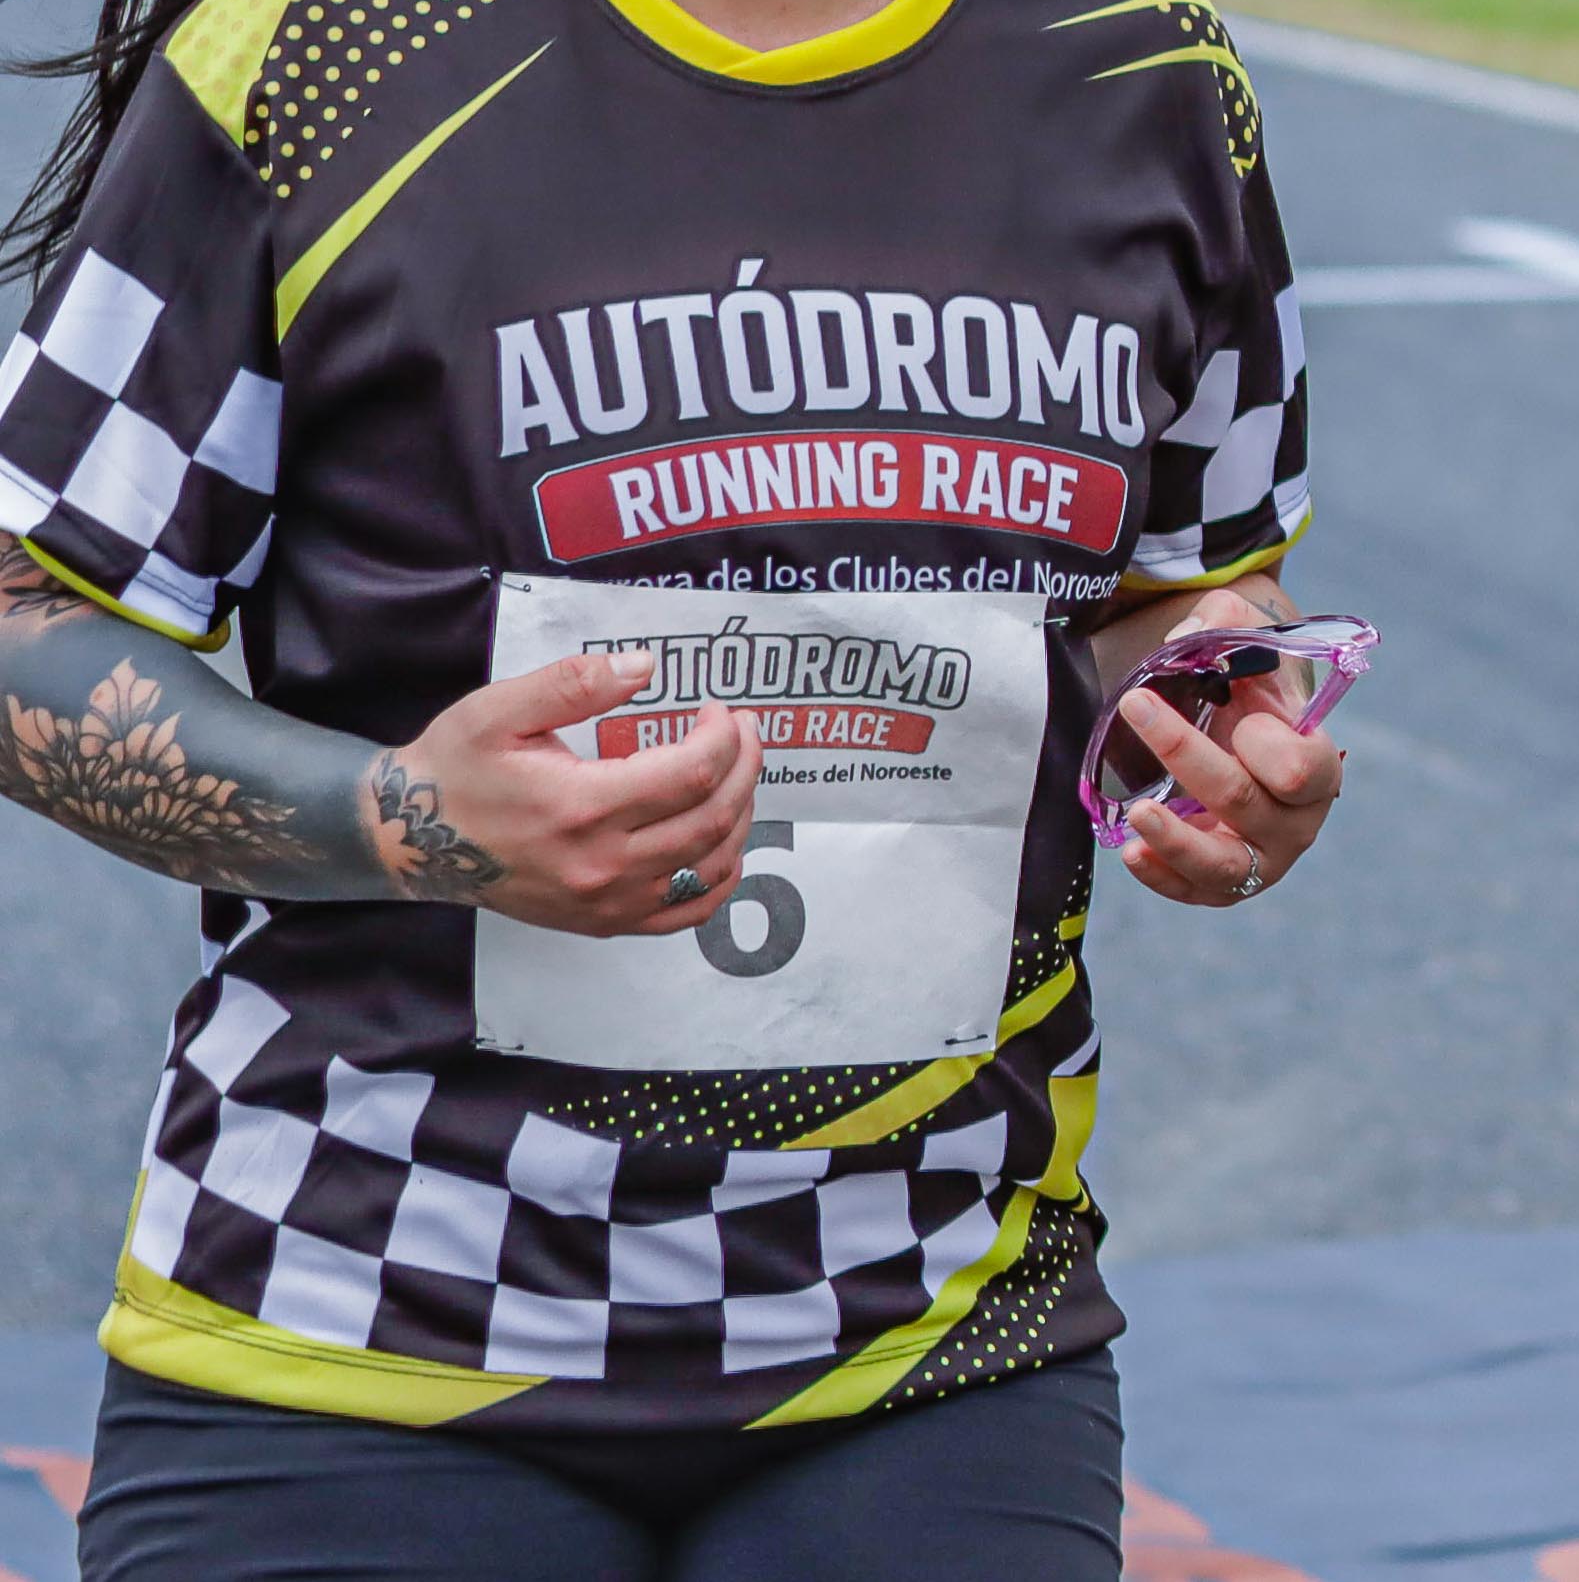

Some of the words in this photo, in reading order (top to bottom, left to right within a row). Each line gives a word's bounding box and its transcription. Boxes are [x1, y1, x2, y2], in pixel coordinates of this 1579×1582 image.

[495, 258, 1147, 459] AUTÓDROMO
[609, 441, 899, 540] RUNNING
[921, 446, 1079, 536] RACE
[706, 558, 752, 592] de
[764, 556, 817, 592] los
[827, 555, 952, 593] Clubes
[962, 556, 1022, 593] del
[582, 616, 971, 711] UTÓDROMO
[757, 765, 817, 784] lubes
[823, 763, 855, 784] del
[861, 763, 953, 782] Noroeste
[804, 711, 895, 746] RACE
[693, 820, 806, 978] 6
